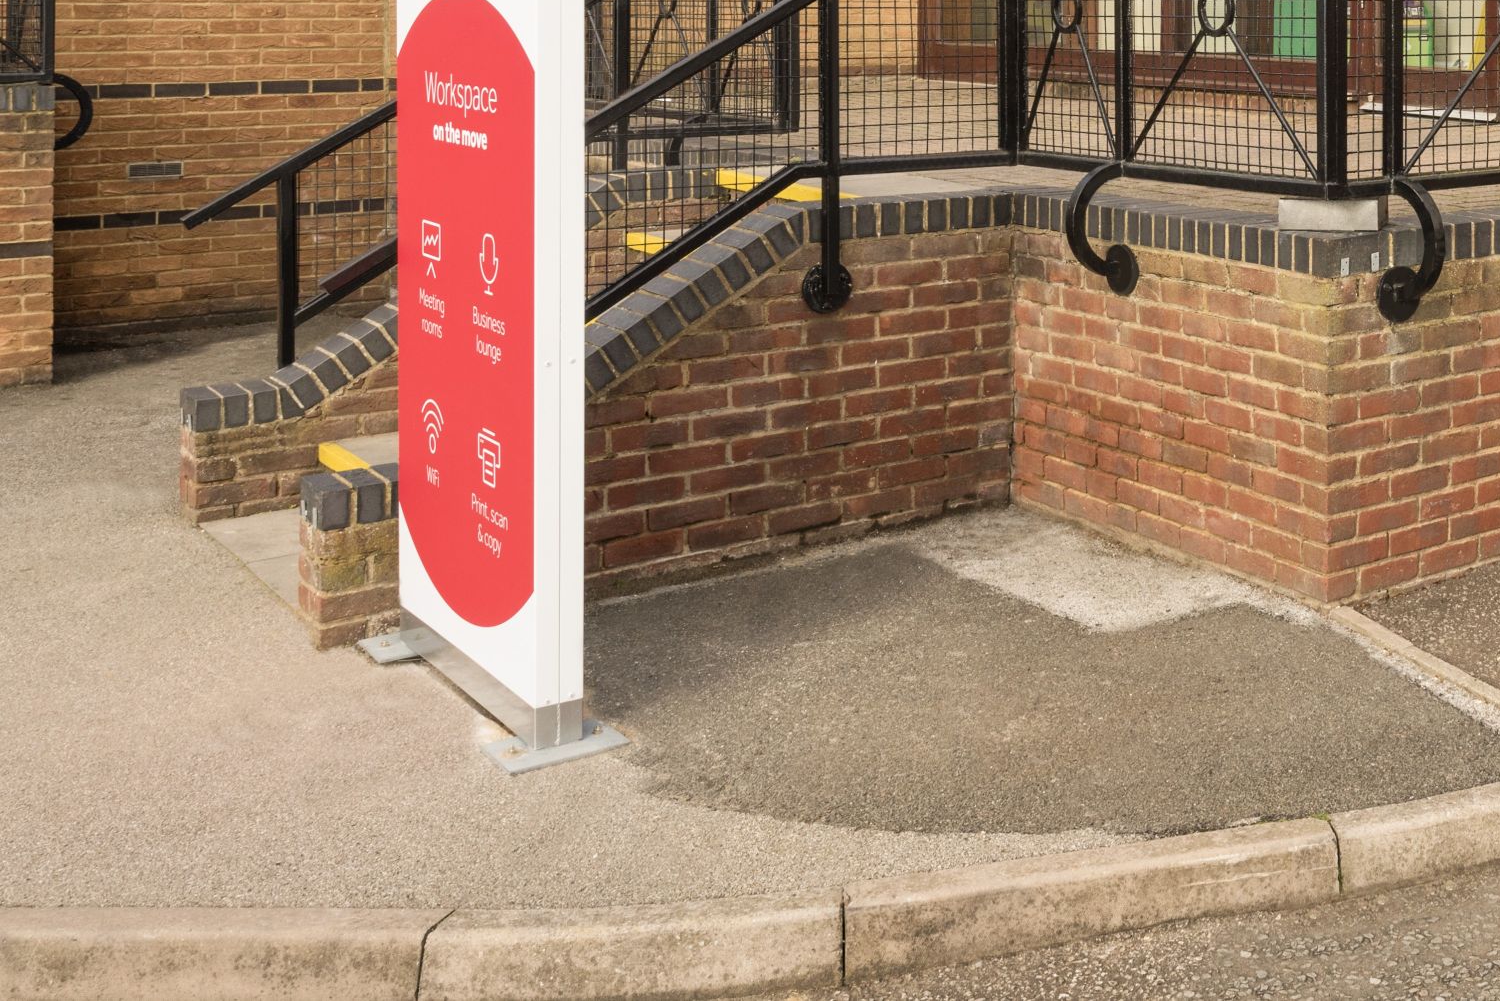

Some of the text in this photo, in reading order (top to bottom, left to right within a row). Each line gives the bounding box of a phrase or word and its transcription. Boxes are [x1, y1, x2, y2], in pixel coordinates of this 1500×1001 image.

[424, 70, 498, 119] Workspace
[432, 121, 488, 151] on the move
[418, 286, 445, 319] Meeting
[421, 318, 443, 339] rooms
[472, 304, 506, 336] Business
[476, 333, 502, 365] lounge
[471, 492, 509, 531] Print, scan
[477, 523, 502, 559] & copy
